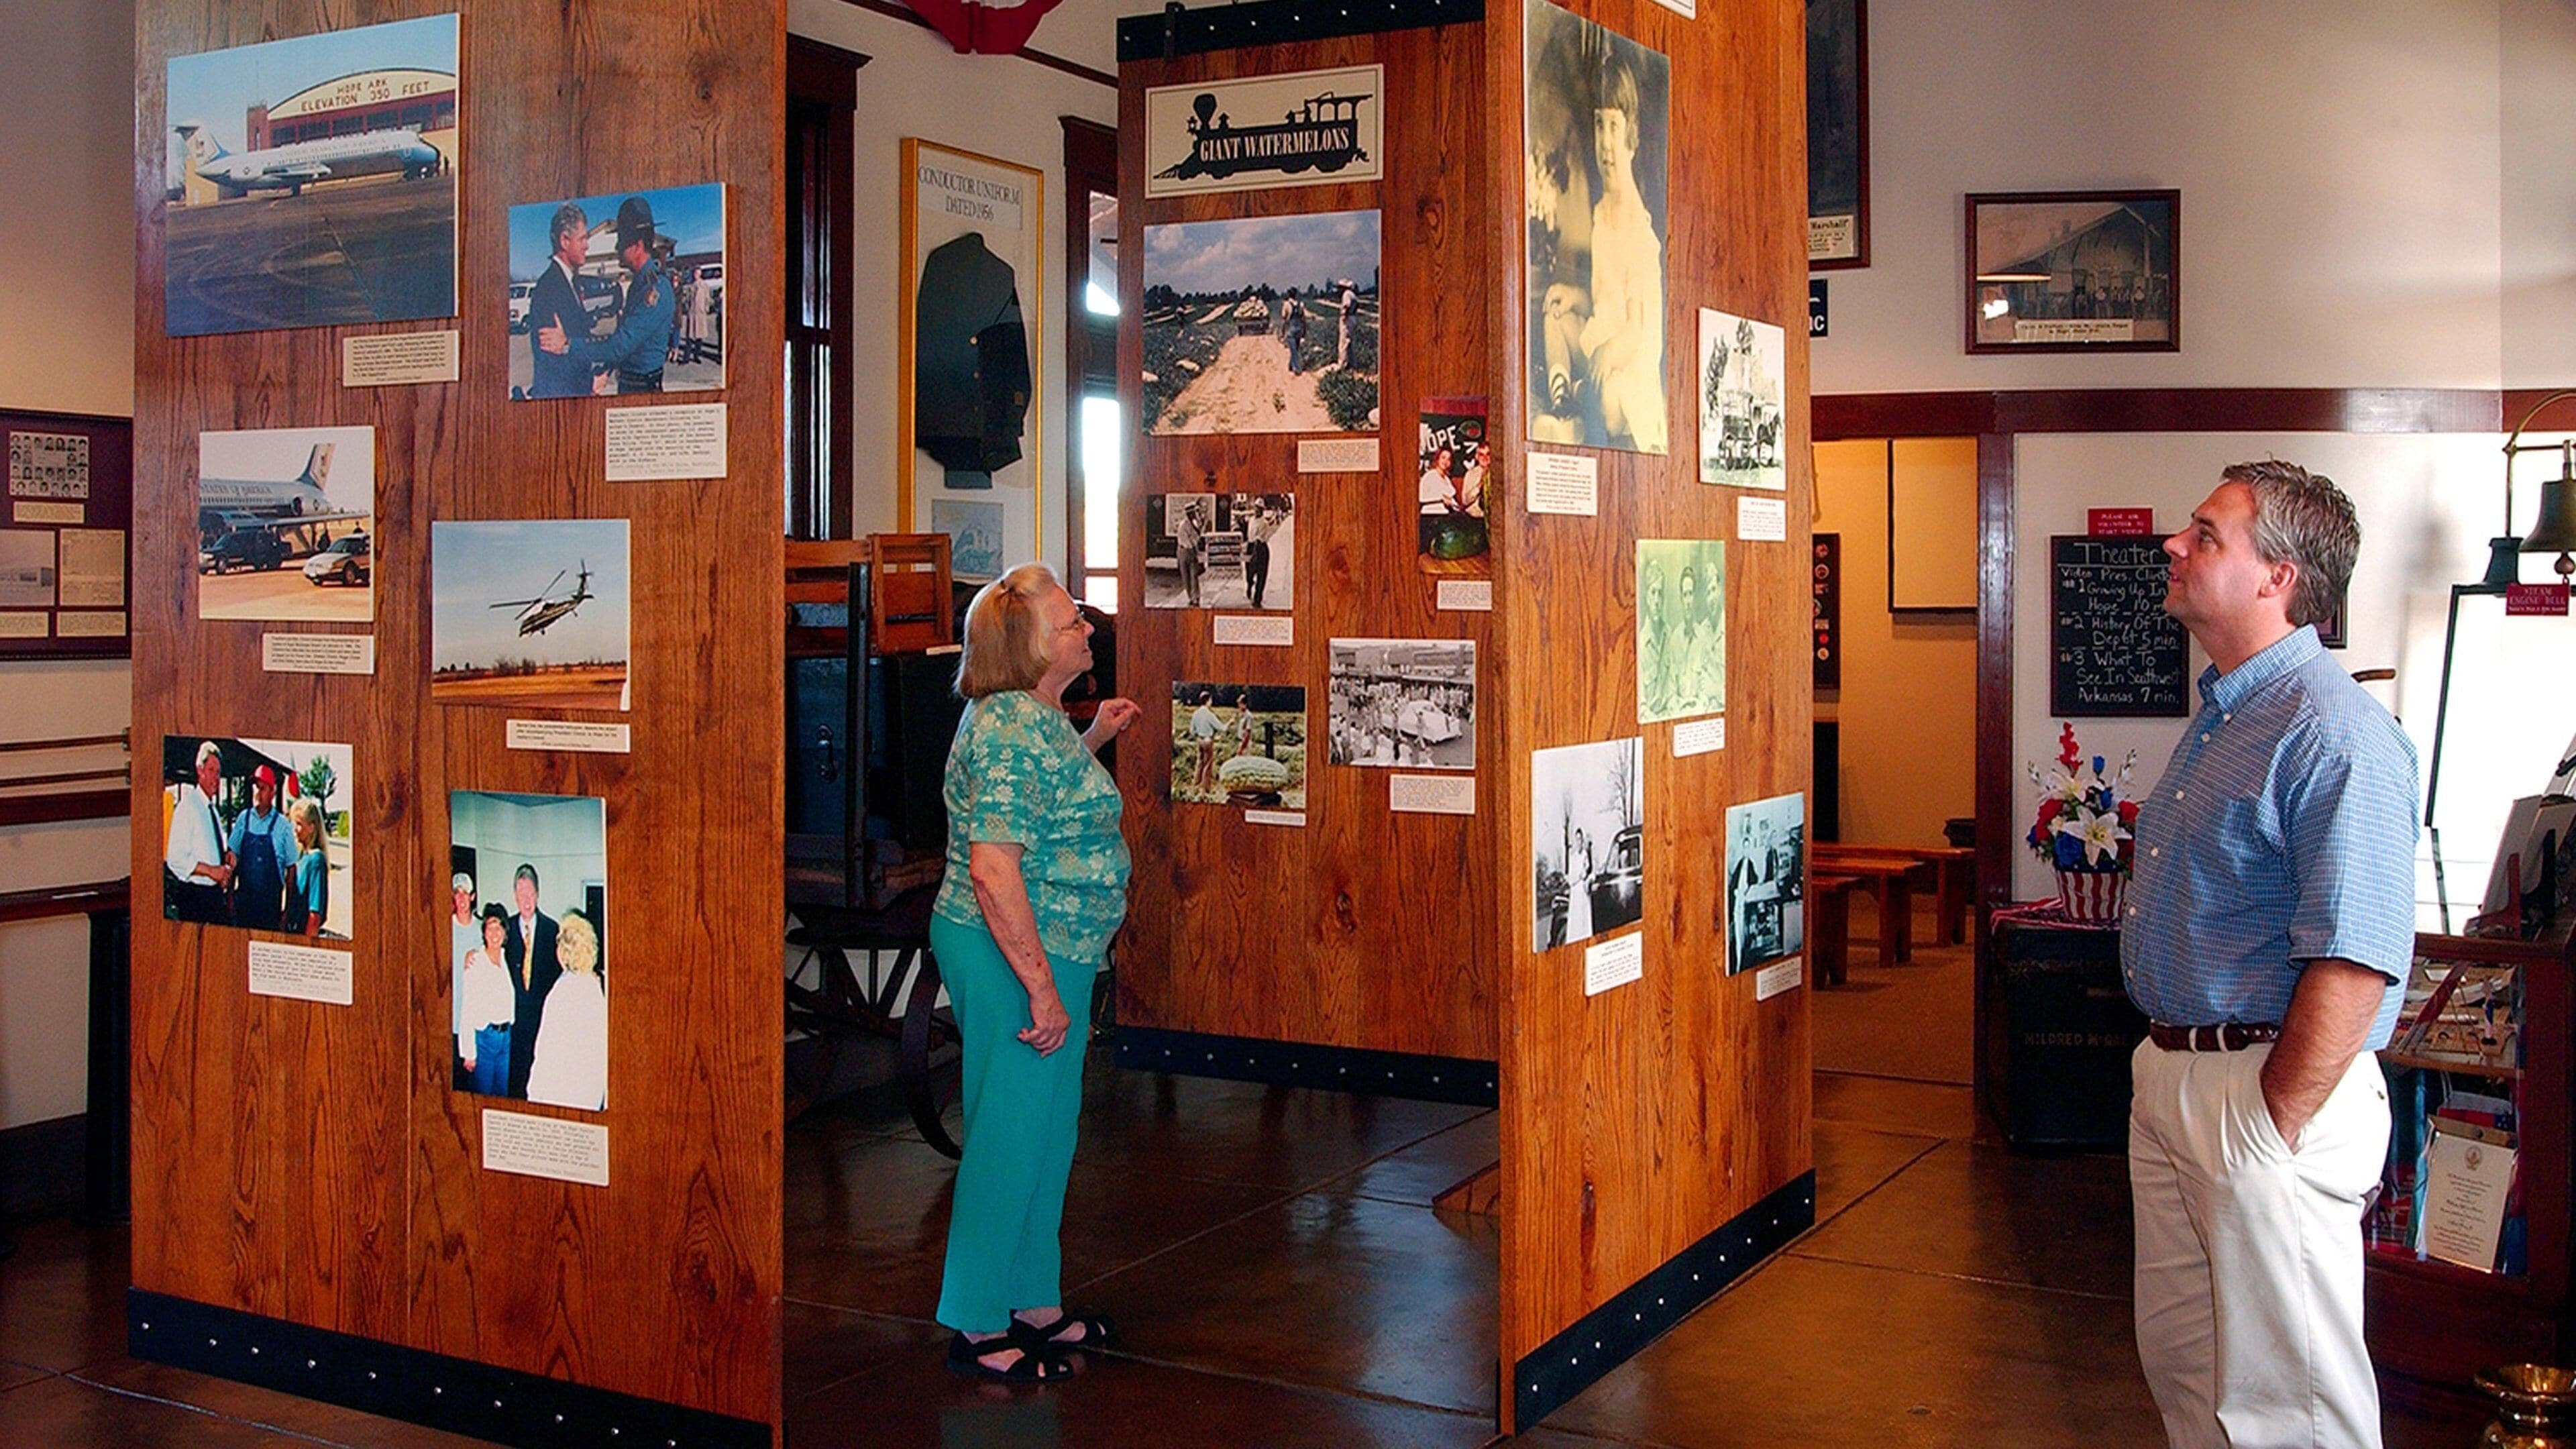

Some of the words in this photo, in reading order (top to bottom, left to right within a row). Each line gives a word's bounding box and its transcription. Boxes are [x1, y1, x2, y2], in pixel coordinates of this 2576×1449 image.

[301, 94, 358, 111] ELEVATION
[402, 81, 429, 95] FEET
[1199, 136, 1241, 162] GIANT
[1244, 127, 1349, 158] WATERMELONS
[918, 166, 975, 195] CONDUCTOR
[976, 180, 1020, 205] UNIFORM
[946, 196, 976, 216] DATED
[2074, 542, 2159, 565] Theater
[2087, 582, 2126, 602] Growing
[2129, 582, 2145, 600] Up
[2149, 582, 2167, 596] In
[2088, 597, 2120, 612] Hope
[2092, 616, 2130, 632] History
[2133, 616, 2152, 630] Of
[2153, 615, 2179, 631] The
[2141, 631, 2151, 647] 5
[2094, 651, 2133, 666] What
[2135, 650, 2156, 667] To
[2076, 667, 2102, 685] See
[2104, 667, 2125, 685] In
[2079, 686, 2133, 703] Arkansas
[2141, 687, 2151, 703] 7
